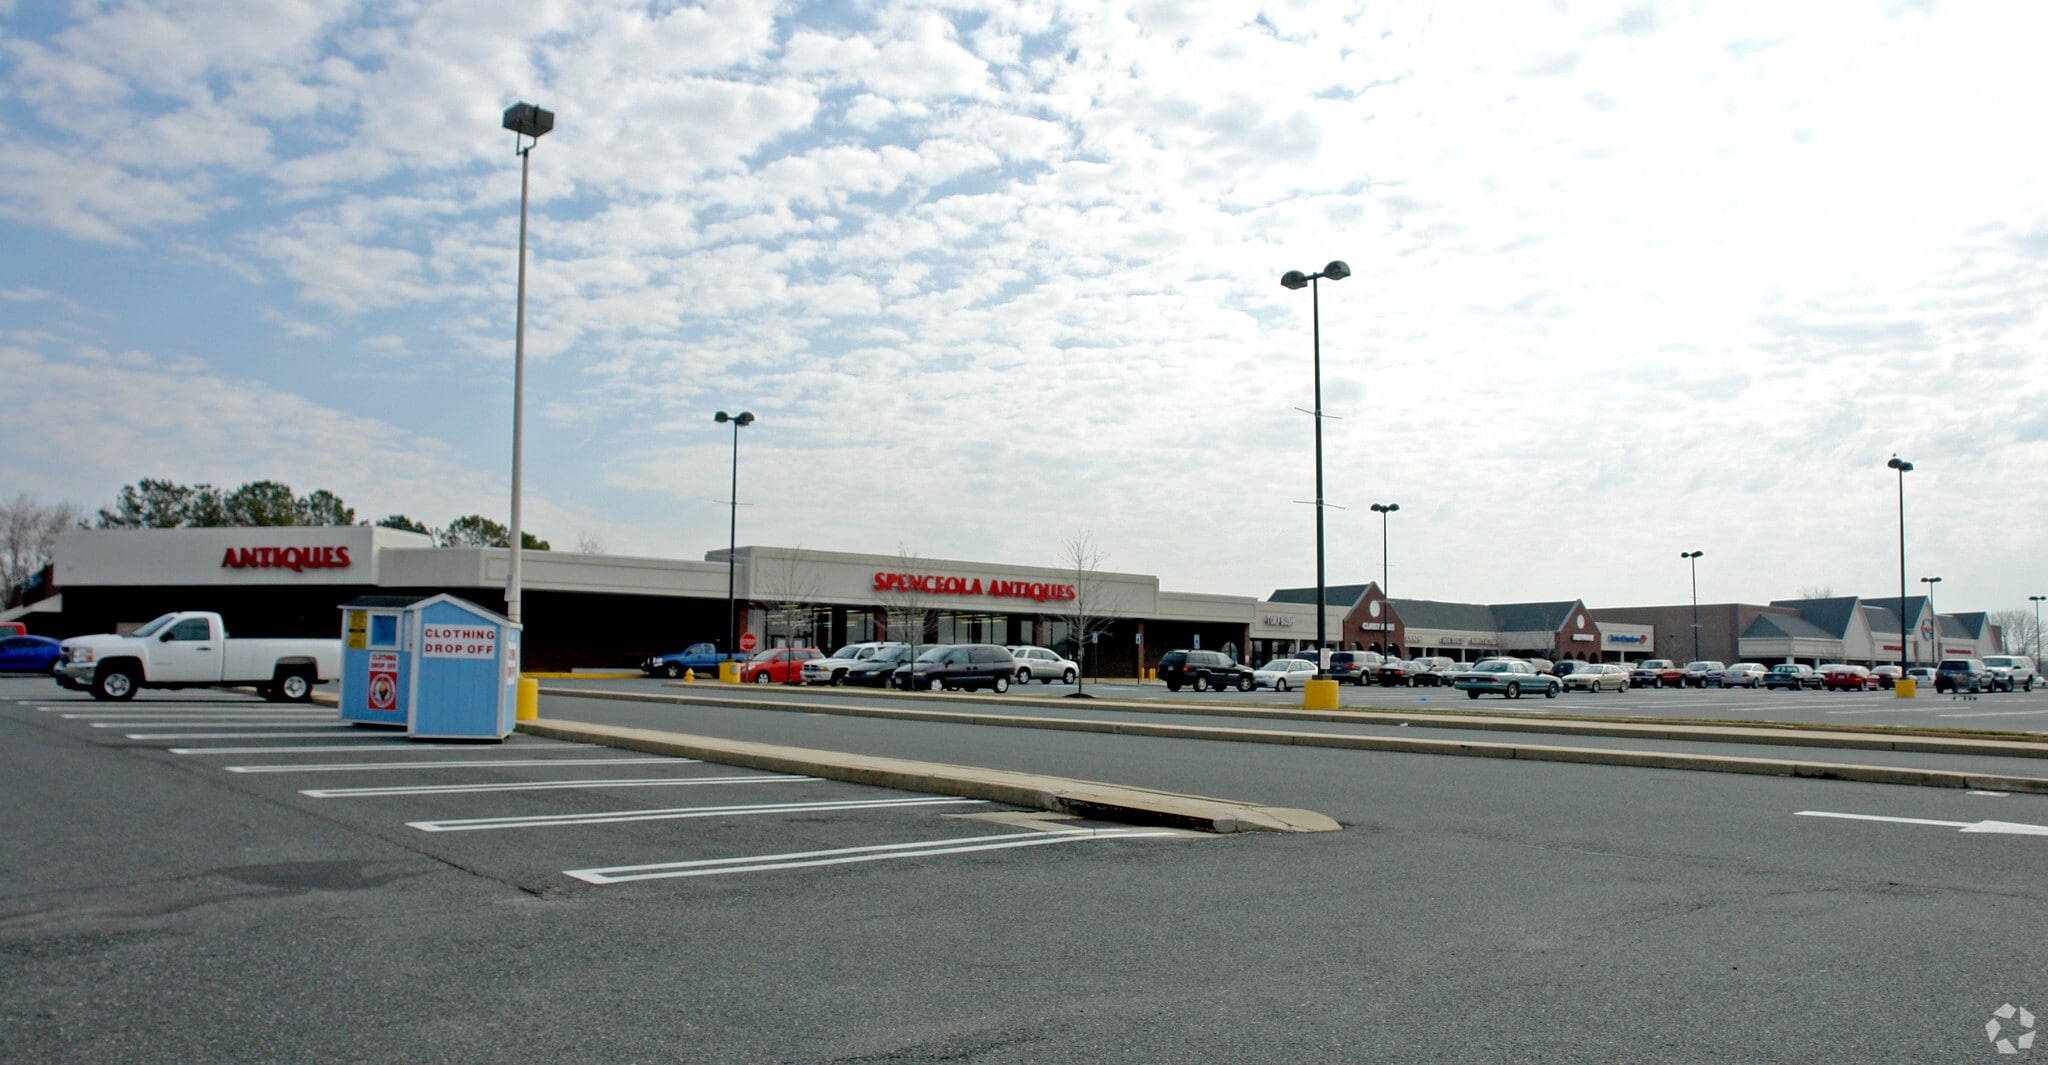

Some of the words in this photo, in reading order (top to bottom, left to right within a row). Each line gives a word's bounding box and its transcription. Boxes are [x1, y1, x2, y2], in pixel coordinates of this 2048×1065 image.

[221, 546, 351, 573] ANTIQUES
[873, 571, 983, 596] SPENCEOLA
[988, 579, 1076, 603] ANTIQUES
[424, 628, 495, 640] CLOTHING
[424, 643, 463, 653] DROP
[467, 644, 493, 655] OFF
